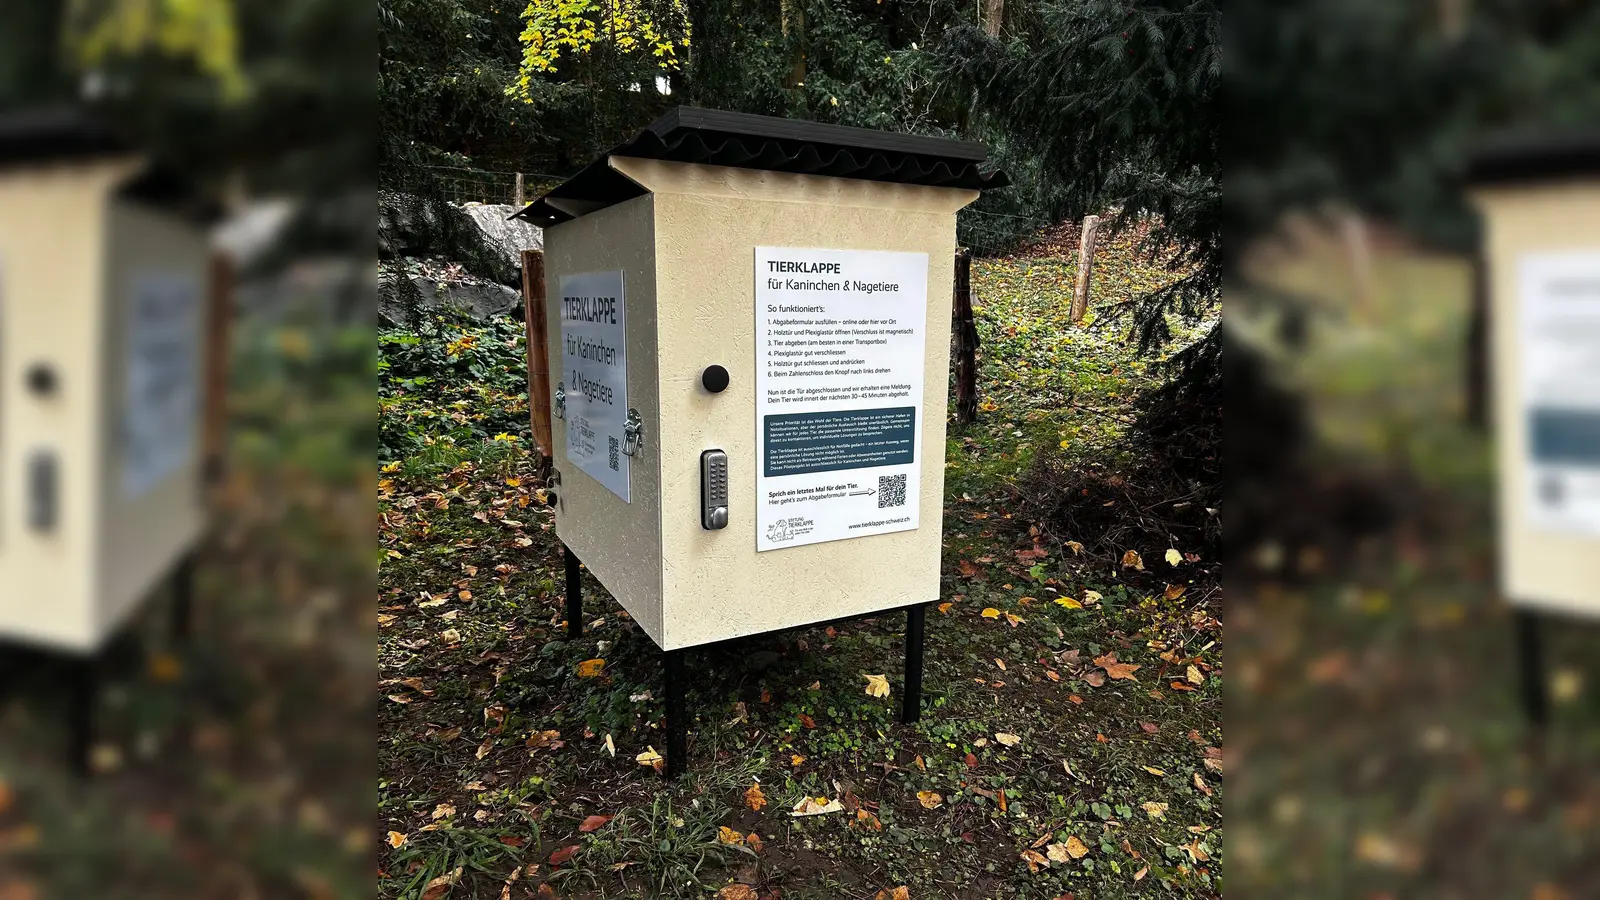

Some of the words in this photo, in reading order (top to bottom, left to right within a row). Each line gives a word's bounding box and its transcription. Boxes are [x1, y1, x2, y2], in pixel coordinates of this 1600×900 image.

[768, 261, 841, 274] TIERKLAPPE
[768, 278, 782, 290] für
[786, 279, 840, 291] Kaninchen
[843, 281, 850, 291] &
[853, 281, 899, 294] Nagetiere
[564, 297, 616, 324] TIERKLAPPE
[768, 305, 777, 313] So
[567, 333, 576, 356] für
[578, 336, 616, 366] Kaninchen
[572, 370, 577, 391] &
[578, 372, 613, 405] Nagetiere
[808, 492, 846, 501] Abgabeformular
[788, 520, 814, 528] TIERKLAPPE
[848, 516, 910, 530] www.tierklappe-schweiz.ch
